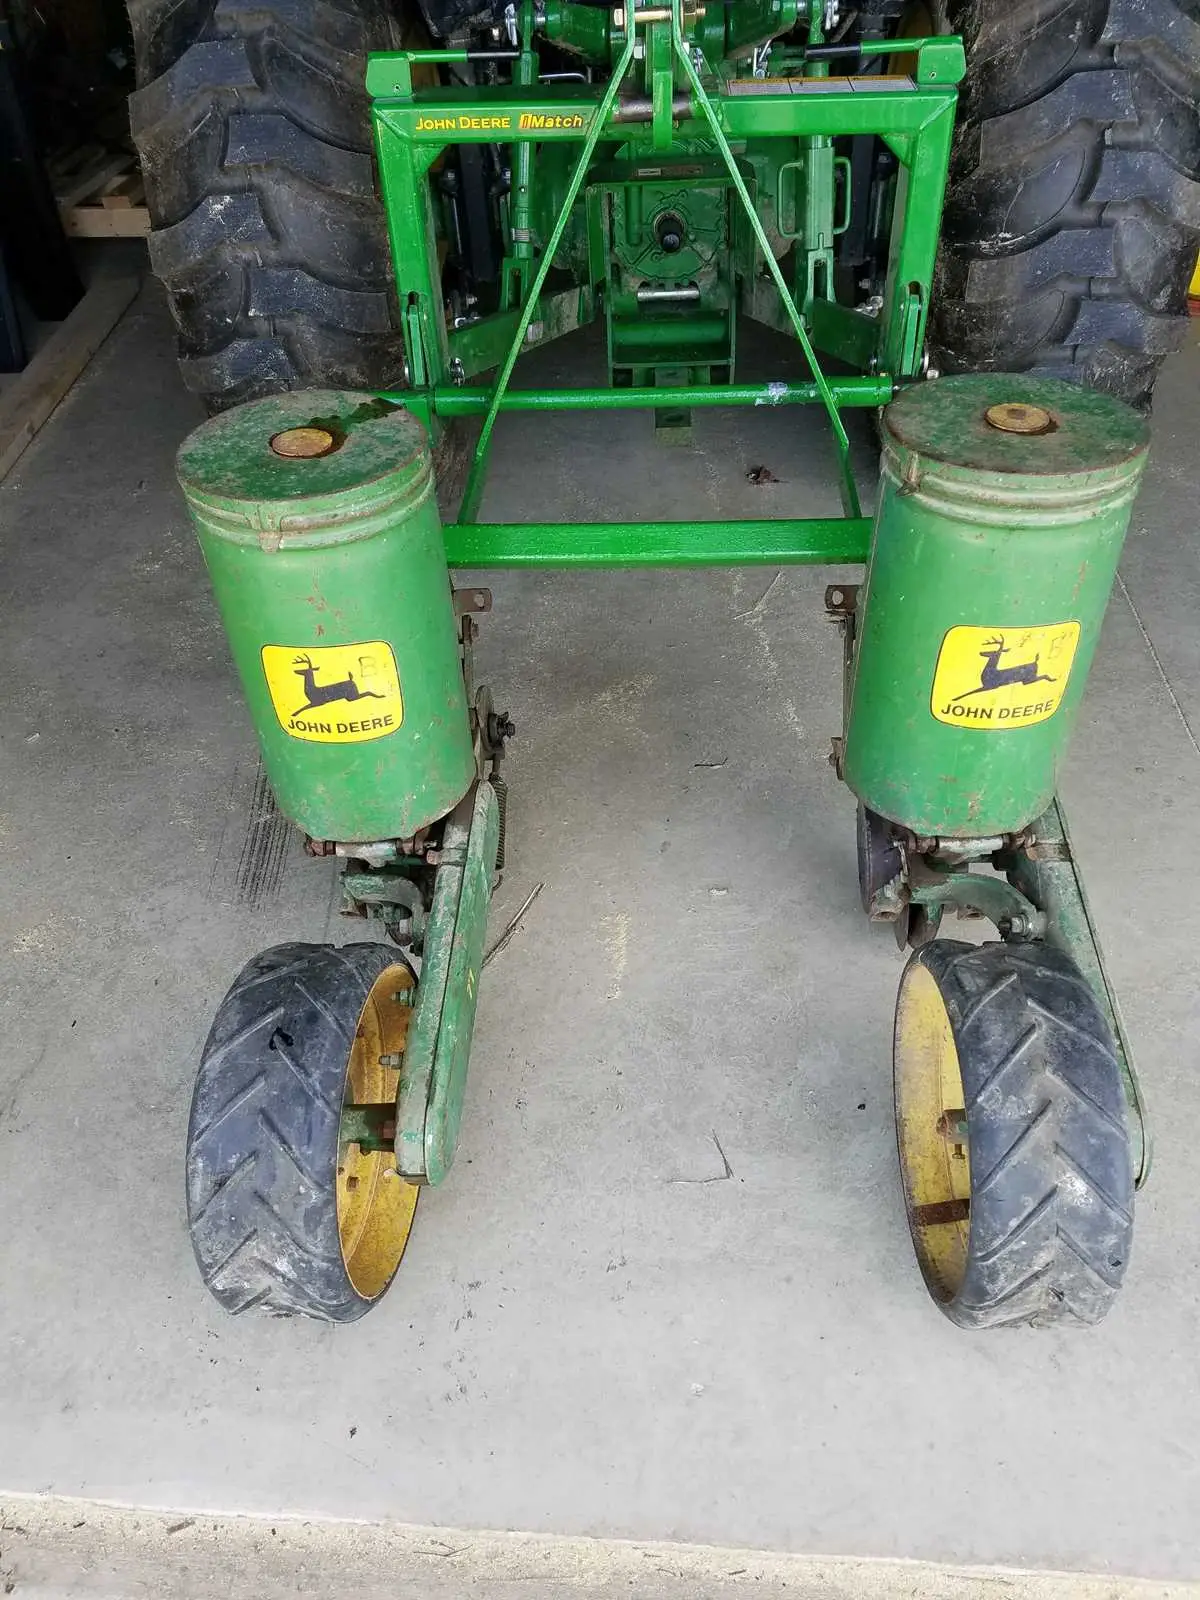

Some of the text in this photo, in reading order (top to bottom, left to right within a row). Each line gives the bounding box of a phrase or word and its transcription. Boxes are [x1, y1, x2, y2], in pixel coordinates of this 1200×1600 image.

[416, 116, 456, 130] JOHN
[459, 116, 511, 129] DEERE
[941, 699, 1054, 719] JOHN DEERE
[287, 714, 395, 734] JOHN DEERE
